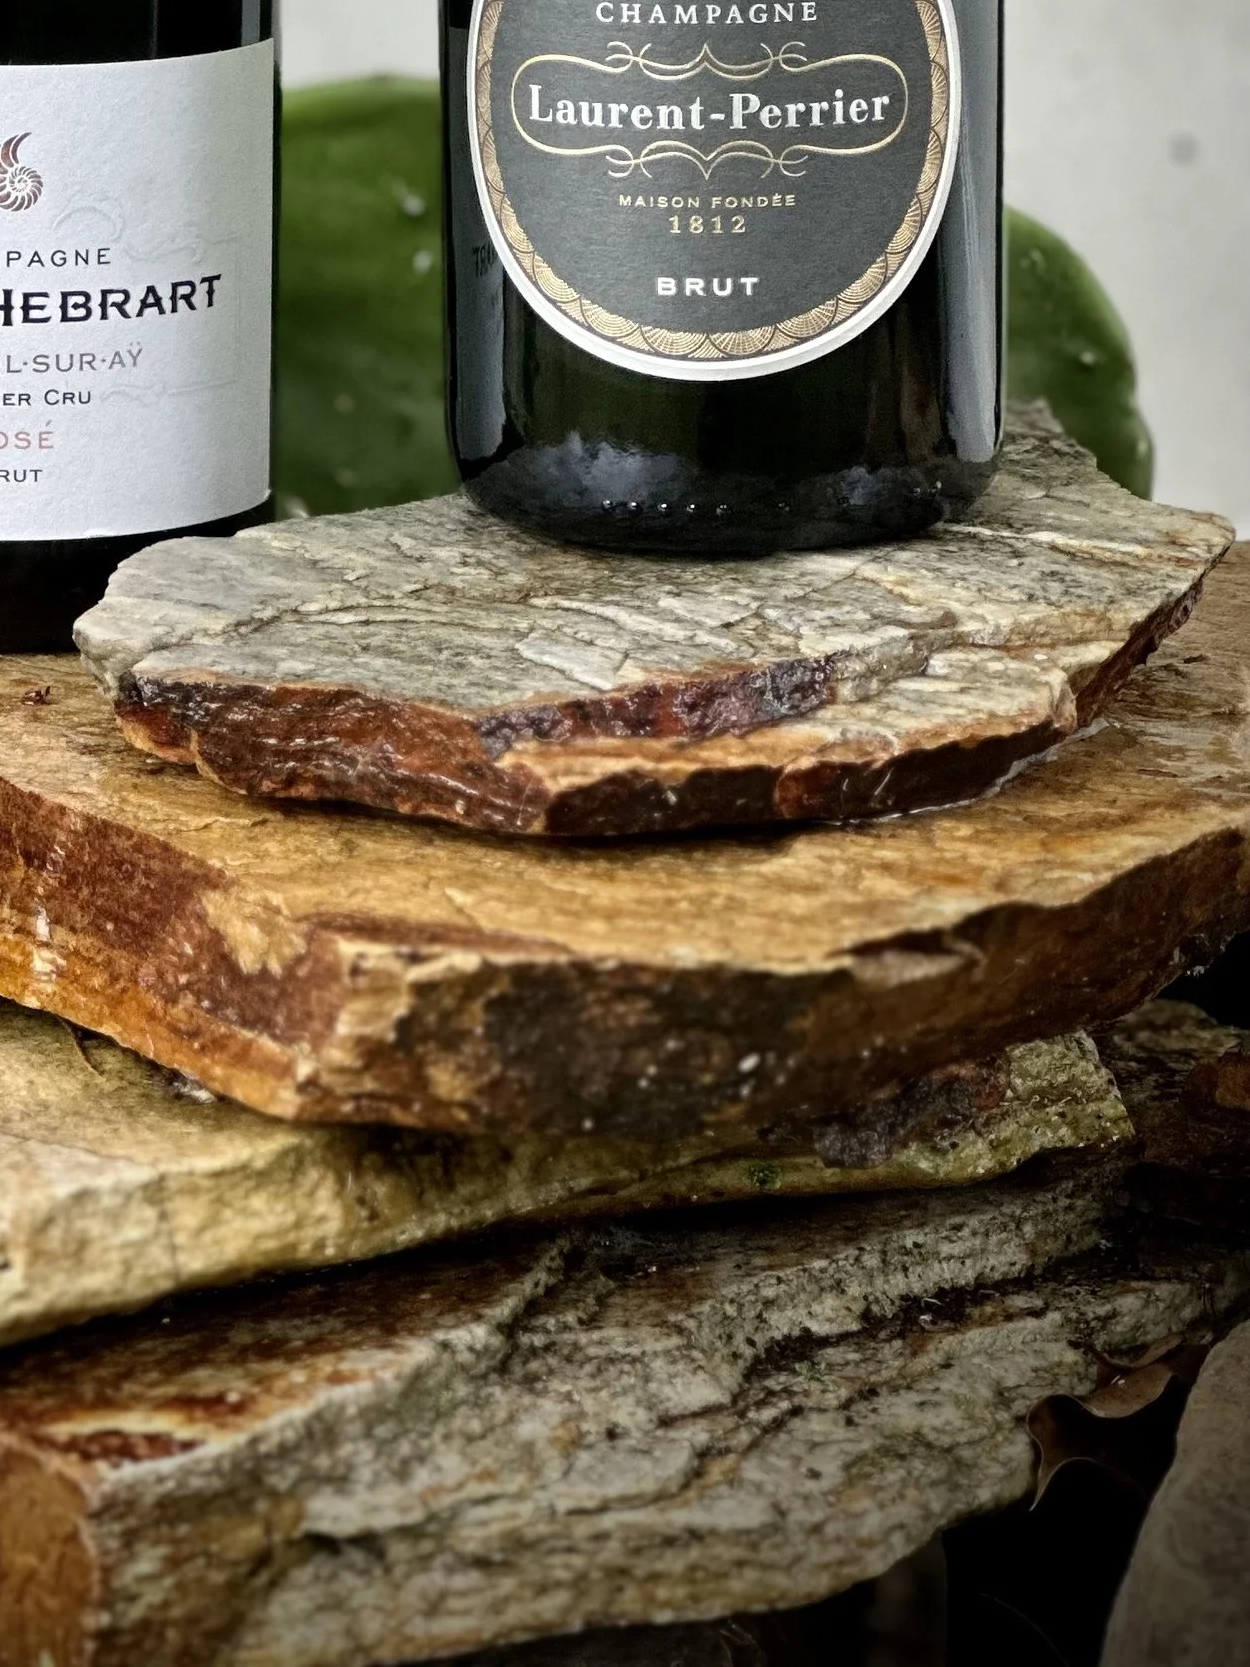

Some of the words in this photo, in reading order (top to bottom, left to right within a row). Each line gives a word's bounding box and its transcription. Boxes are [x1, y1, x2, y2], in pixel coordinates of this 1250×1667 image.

[595, 1, 819, 25] CHAMPAGNE
[528, 83, 891, 131] Laurent-Perrier
[618, 194, 701, 209] MAISON
[711, 192, 797, 208] FONDÉE
[668, 214, 748, 235] 1812
[656, 276, 760, 297] BRUT
[43, 388, 93, 406] CRU
